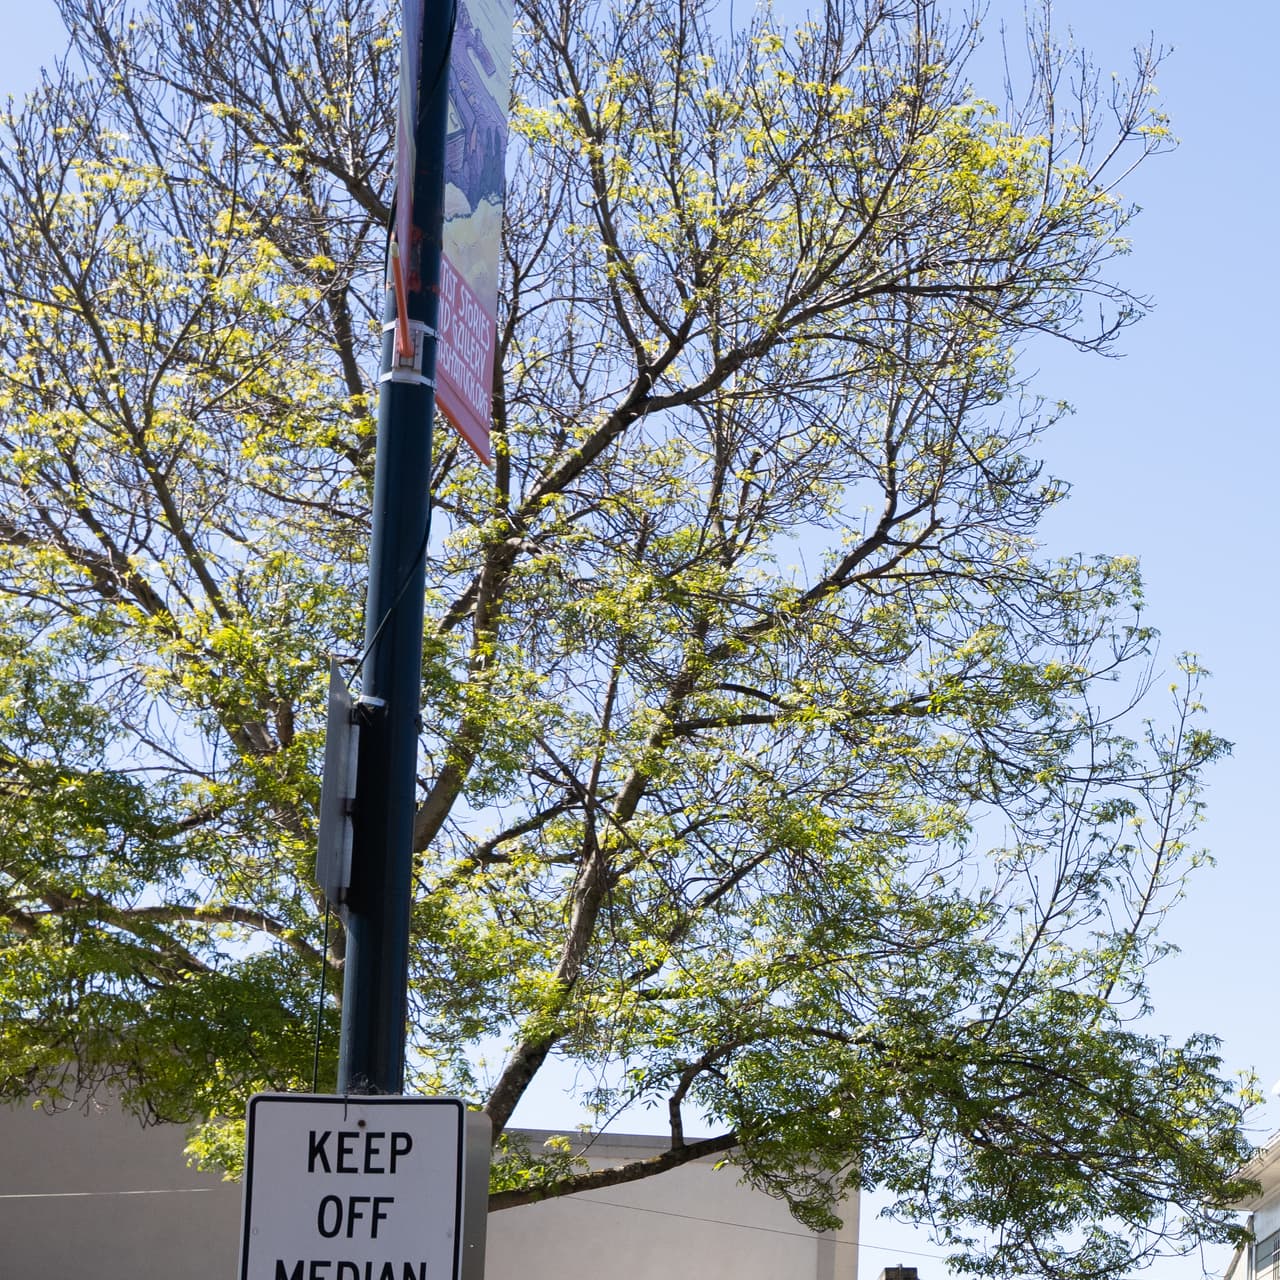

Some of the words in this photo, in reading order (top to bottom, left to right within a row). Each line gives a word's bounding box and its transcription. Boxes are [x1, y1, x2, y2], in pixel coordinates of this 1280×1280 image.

[459, 285, 490, 352] STORIES
[452, 314, 486, 381] GALLERY
[307, 1130, 413, 1174] KEEP
[317, 1195, 395, 1239] OFF
